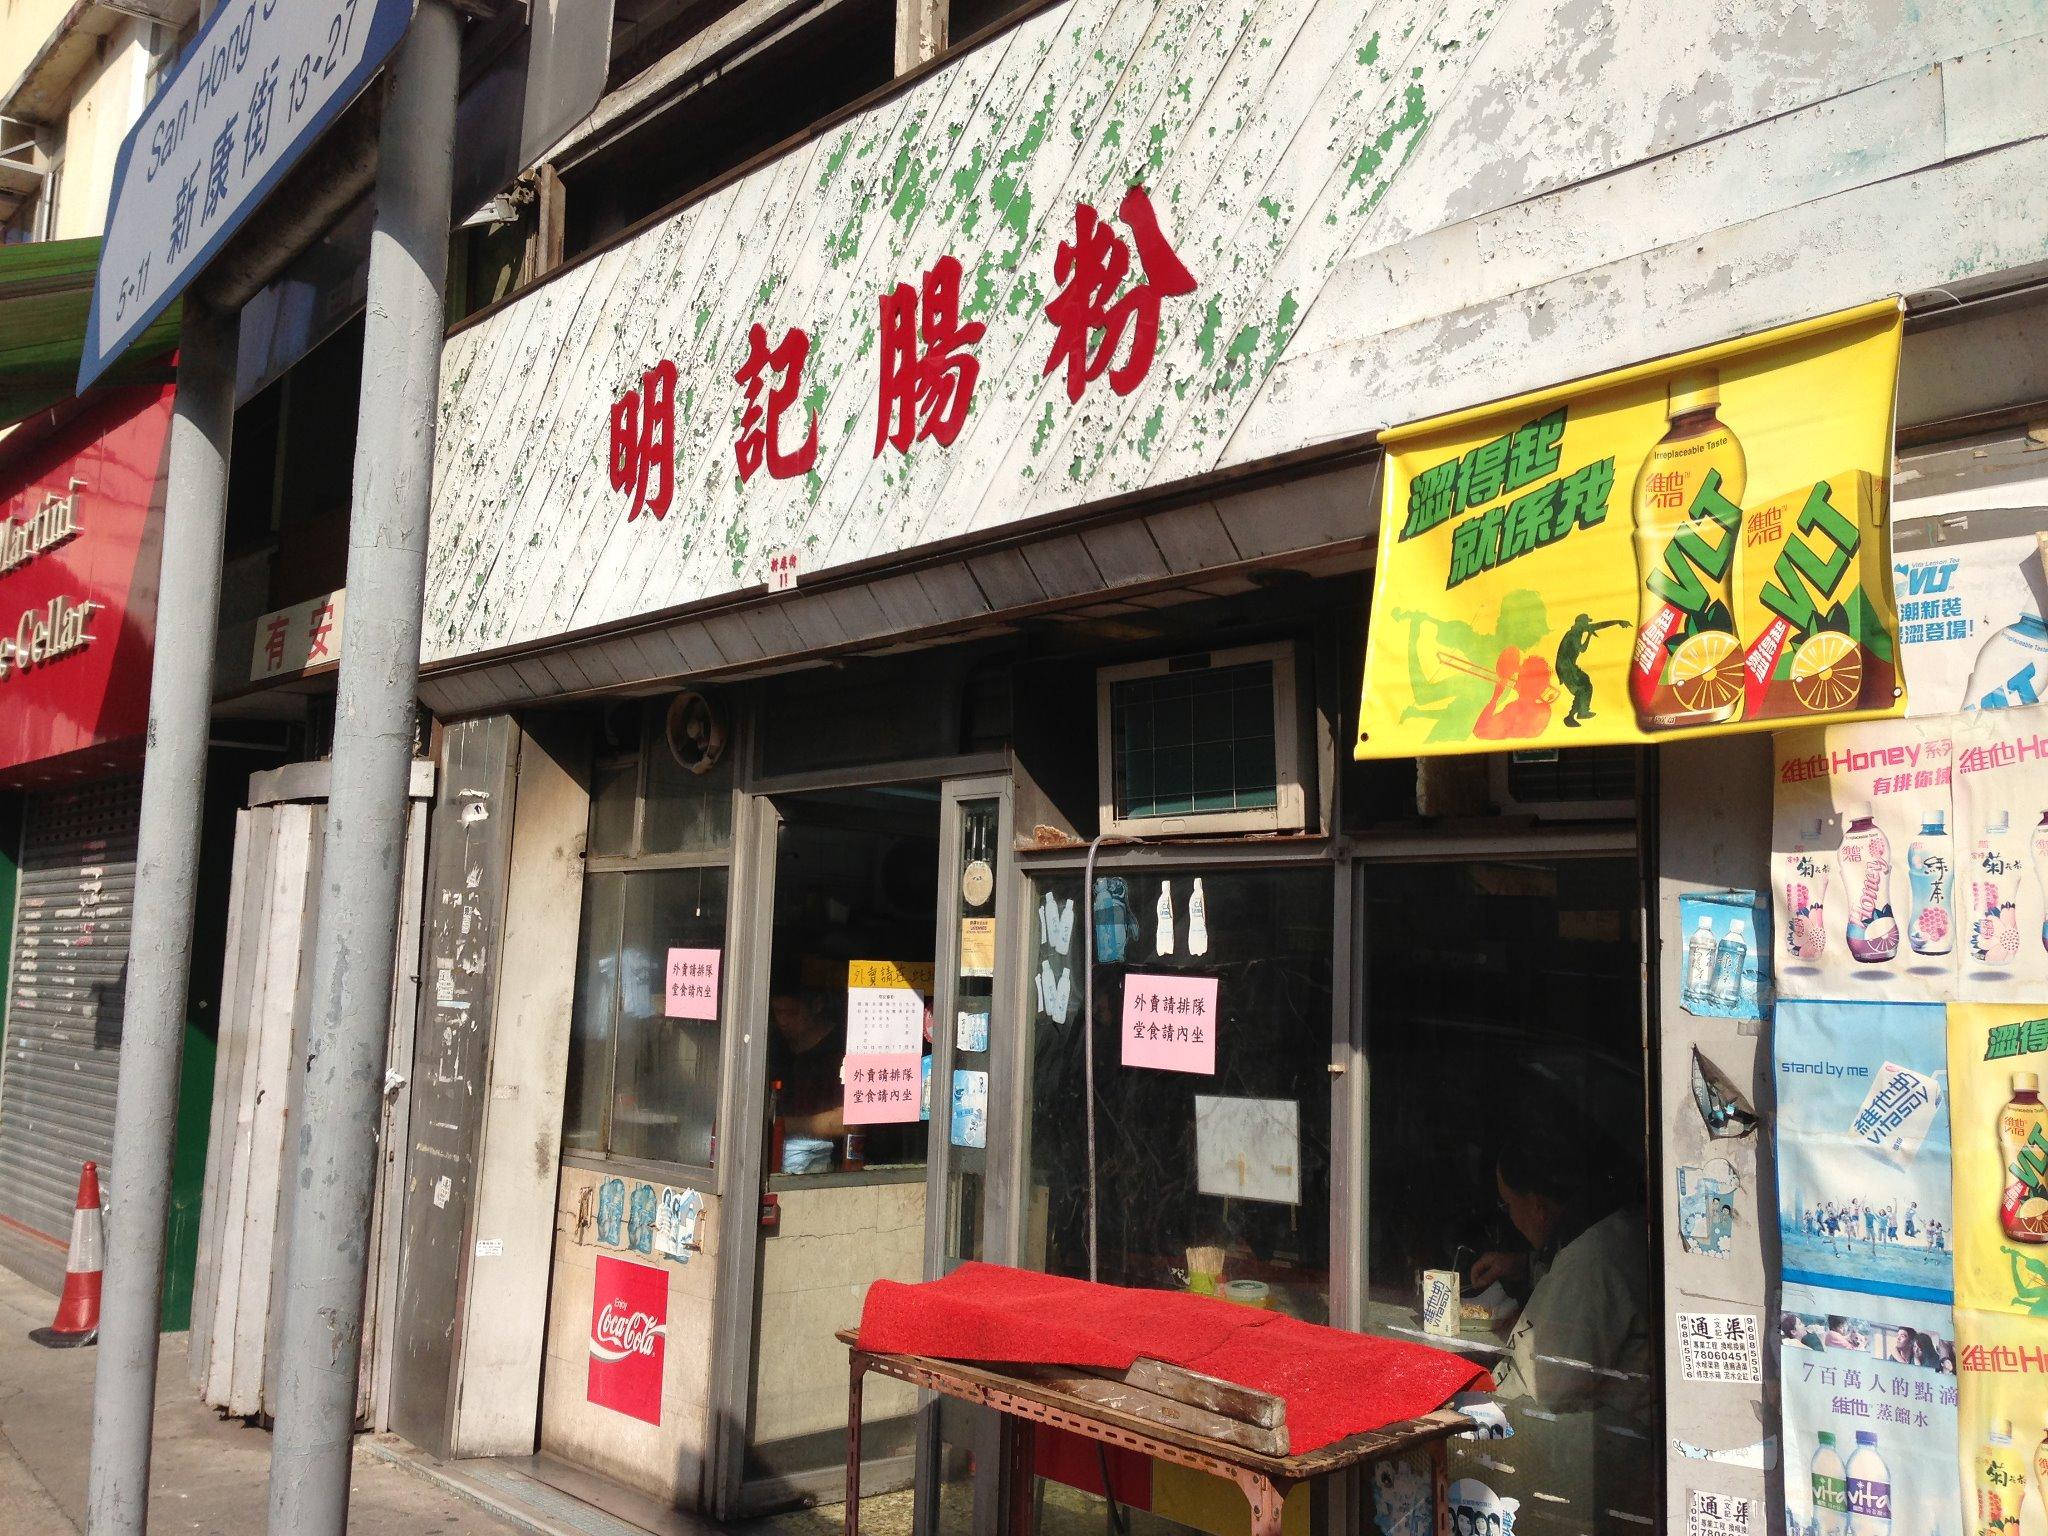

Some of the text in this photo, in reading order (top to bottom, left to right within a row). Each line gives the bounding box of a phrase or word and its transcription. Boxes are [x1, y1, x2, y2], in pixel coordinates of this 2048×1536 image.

[146, 1, 255, 183] San Hong
[167, 55, 280, 264] 新康街
[609, 186, 1198, 522] 明記腸粉
[1654, 437, 1728, 460] Irreplaceable Taste
[1399, 405, 1568, 543] 澀得起
[1446, 455, 1615, 591] 就係我
[1646, 467, 1744, 614] VLT
[1758, 480, 1861, 634] VLT
[1909, 563, 1960, 596] VLT
[15, 594, 97, 669] Cellar
[263, 600, 334, 672] 有安
[1781, 754, 1830, 784] 維他
[1831, 742, 1921, 775] Honey
[1959, 741, 2016, 775] 維他
[672, 962, 713, 978] 外賣請排隊
[1133, 993, 1206, 1016] 外賣請排隊
[1132, 1020, 1205, 1043] 堂食請內坐
[853, 1067, 914, 1083] 外賣請排隊
[1781, 1061, 1869, 1079] stand by me
[853, 1088, 913, 1104] 堂食請內坐
[1854, 1072, 1921, 1136] 維他奶
[614, 1298, 628, 1310] Enjoy
[1693, 1350, 1748, 1361] 78060451
[1961, 1344, 2019, 1373] 維他
[1831, 1396, 1929, 1428] 維他 蒸餾水
[1848, 1481, 1889, 1509] vita
